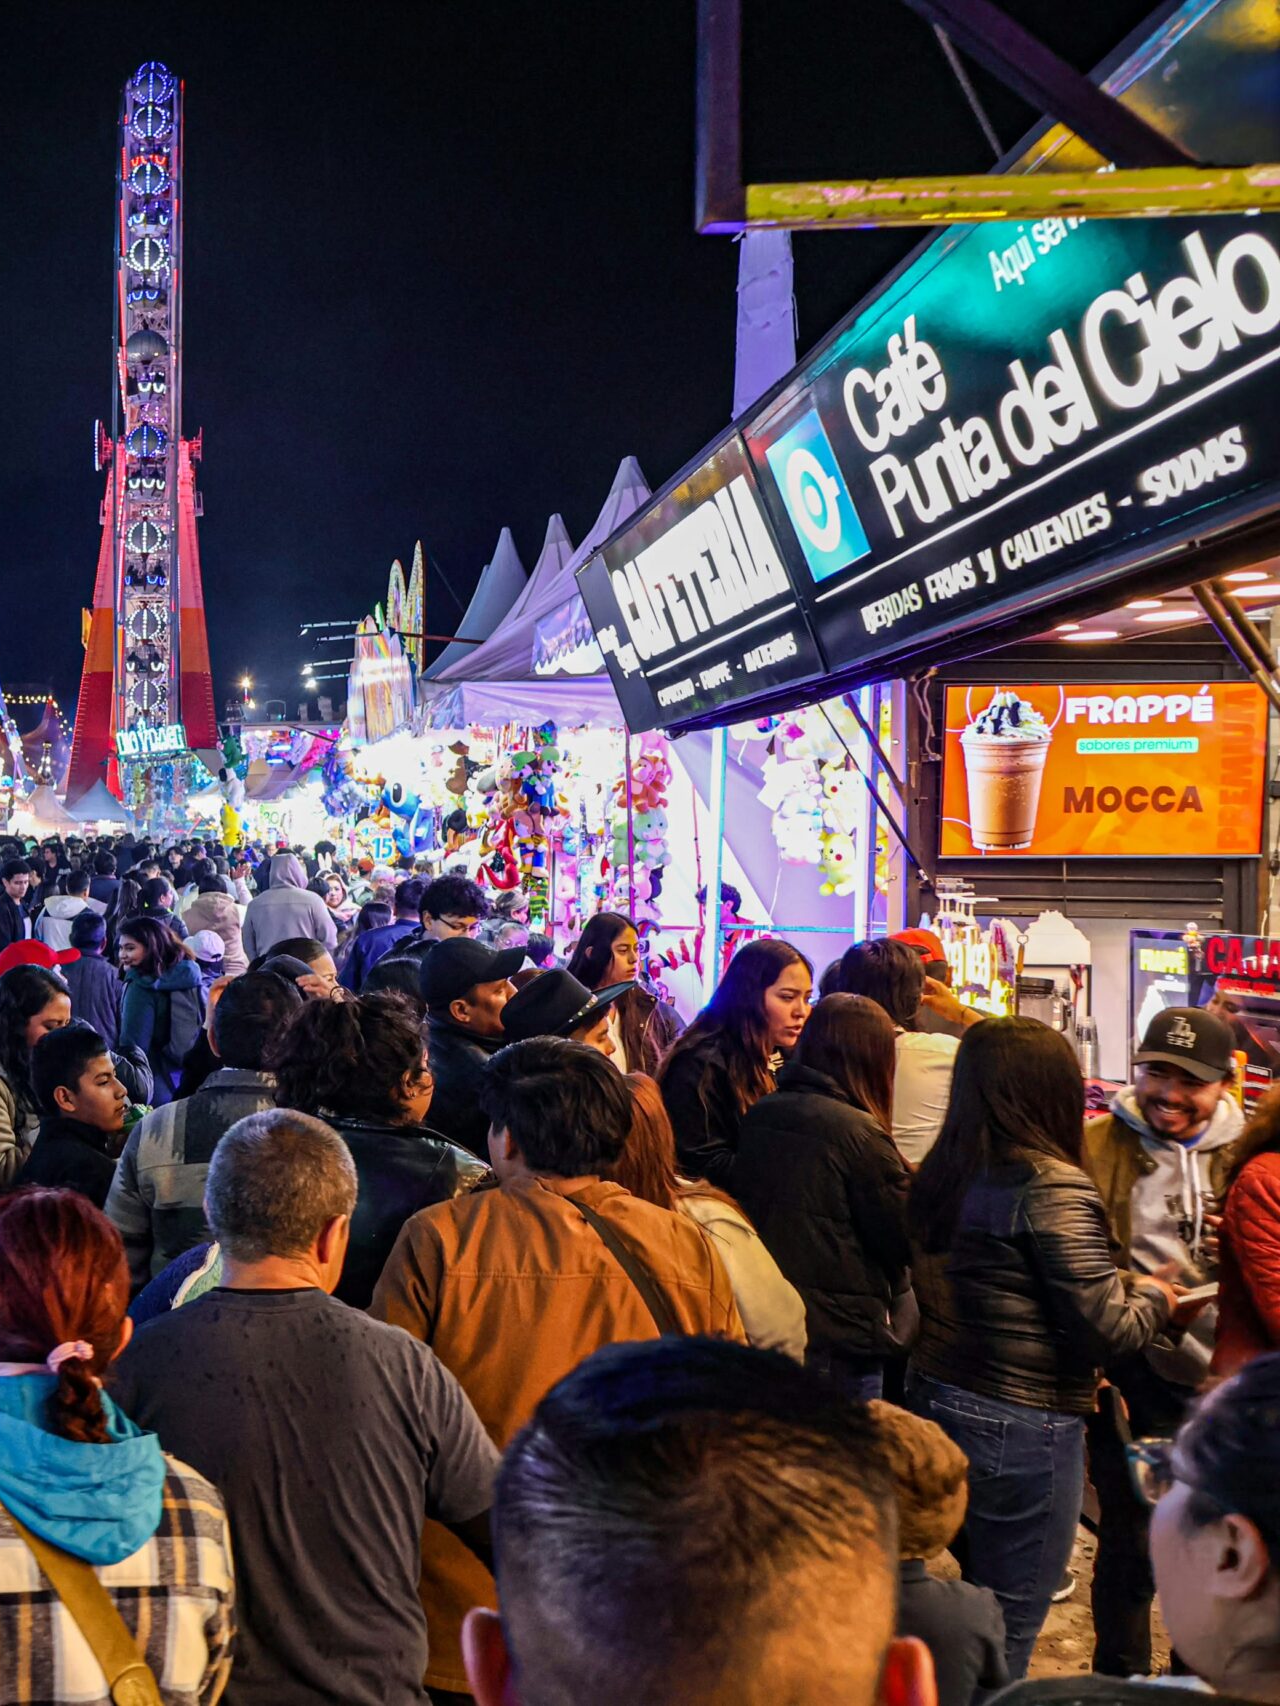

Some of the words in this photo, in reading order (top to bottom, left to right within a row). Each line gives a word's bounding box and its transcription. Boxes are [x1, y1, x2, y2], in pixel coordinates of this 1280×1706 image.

[988, 224, 1036, 292] Aqui
[843, 314, 948, 453] Café
[869, 416, 1010, 539] Punta
[999, 328, 1099, 467] del
[1082, 230, 1280, 409] Cielo
[924, 558, 977, 604] FRIAS
[1001, 492, 1112, 571] CALIENTES
[1138, 425, 1248, 508] SODAS
[612, 474, 791, 661] CAFETERIA
[1065, 684, 1214, 725] FRAPPÉ
[1078, 739, 1131, 751] sabores
[1133, 738, 1192, 753] premium
[1063, 786, 1204, 814] MOCCA
[371, 837, 393, 859] 15
